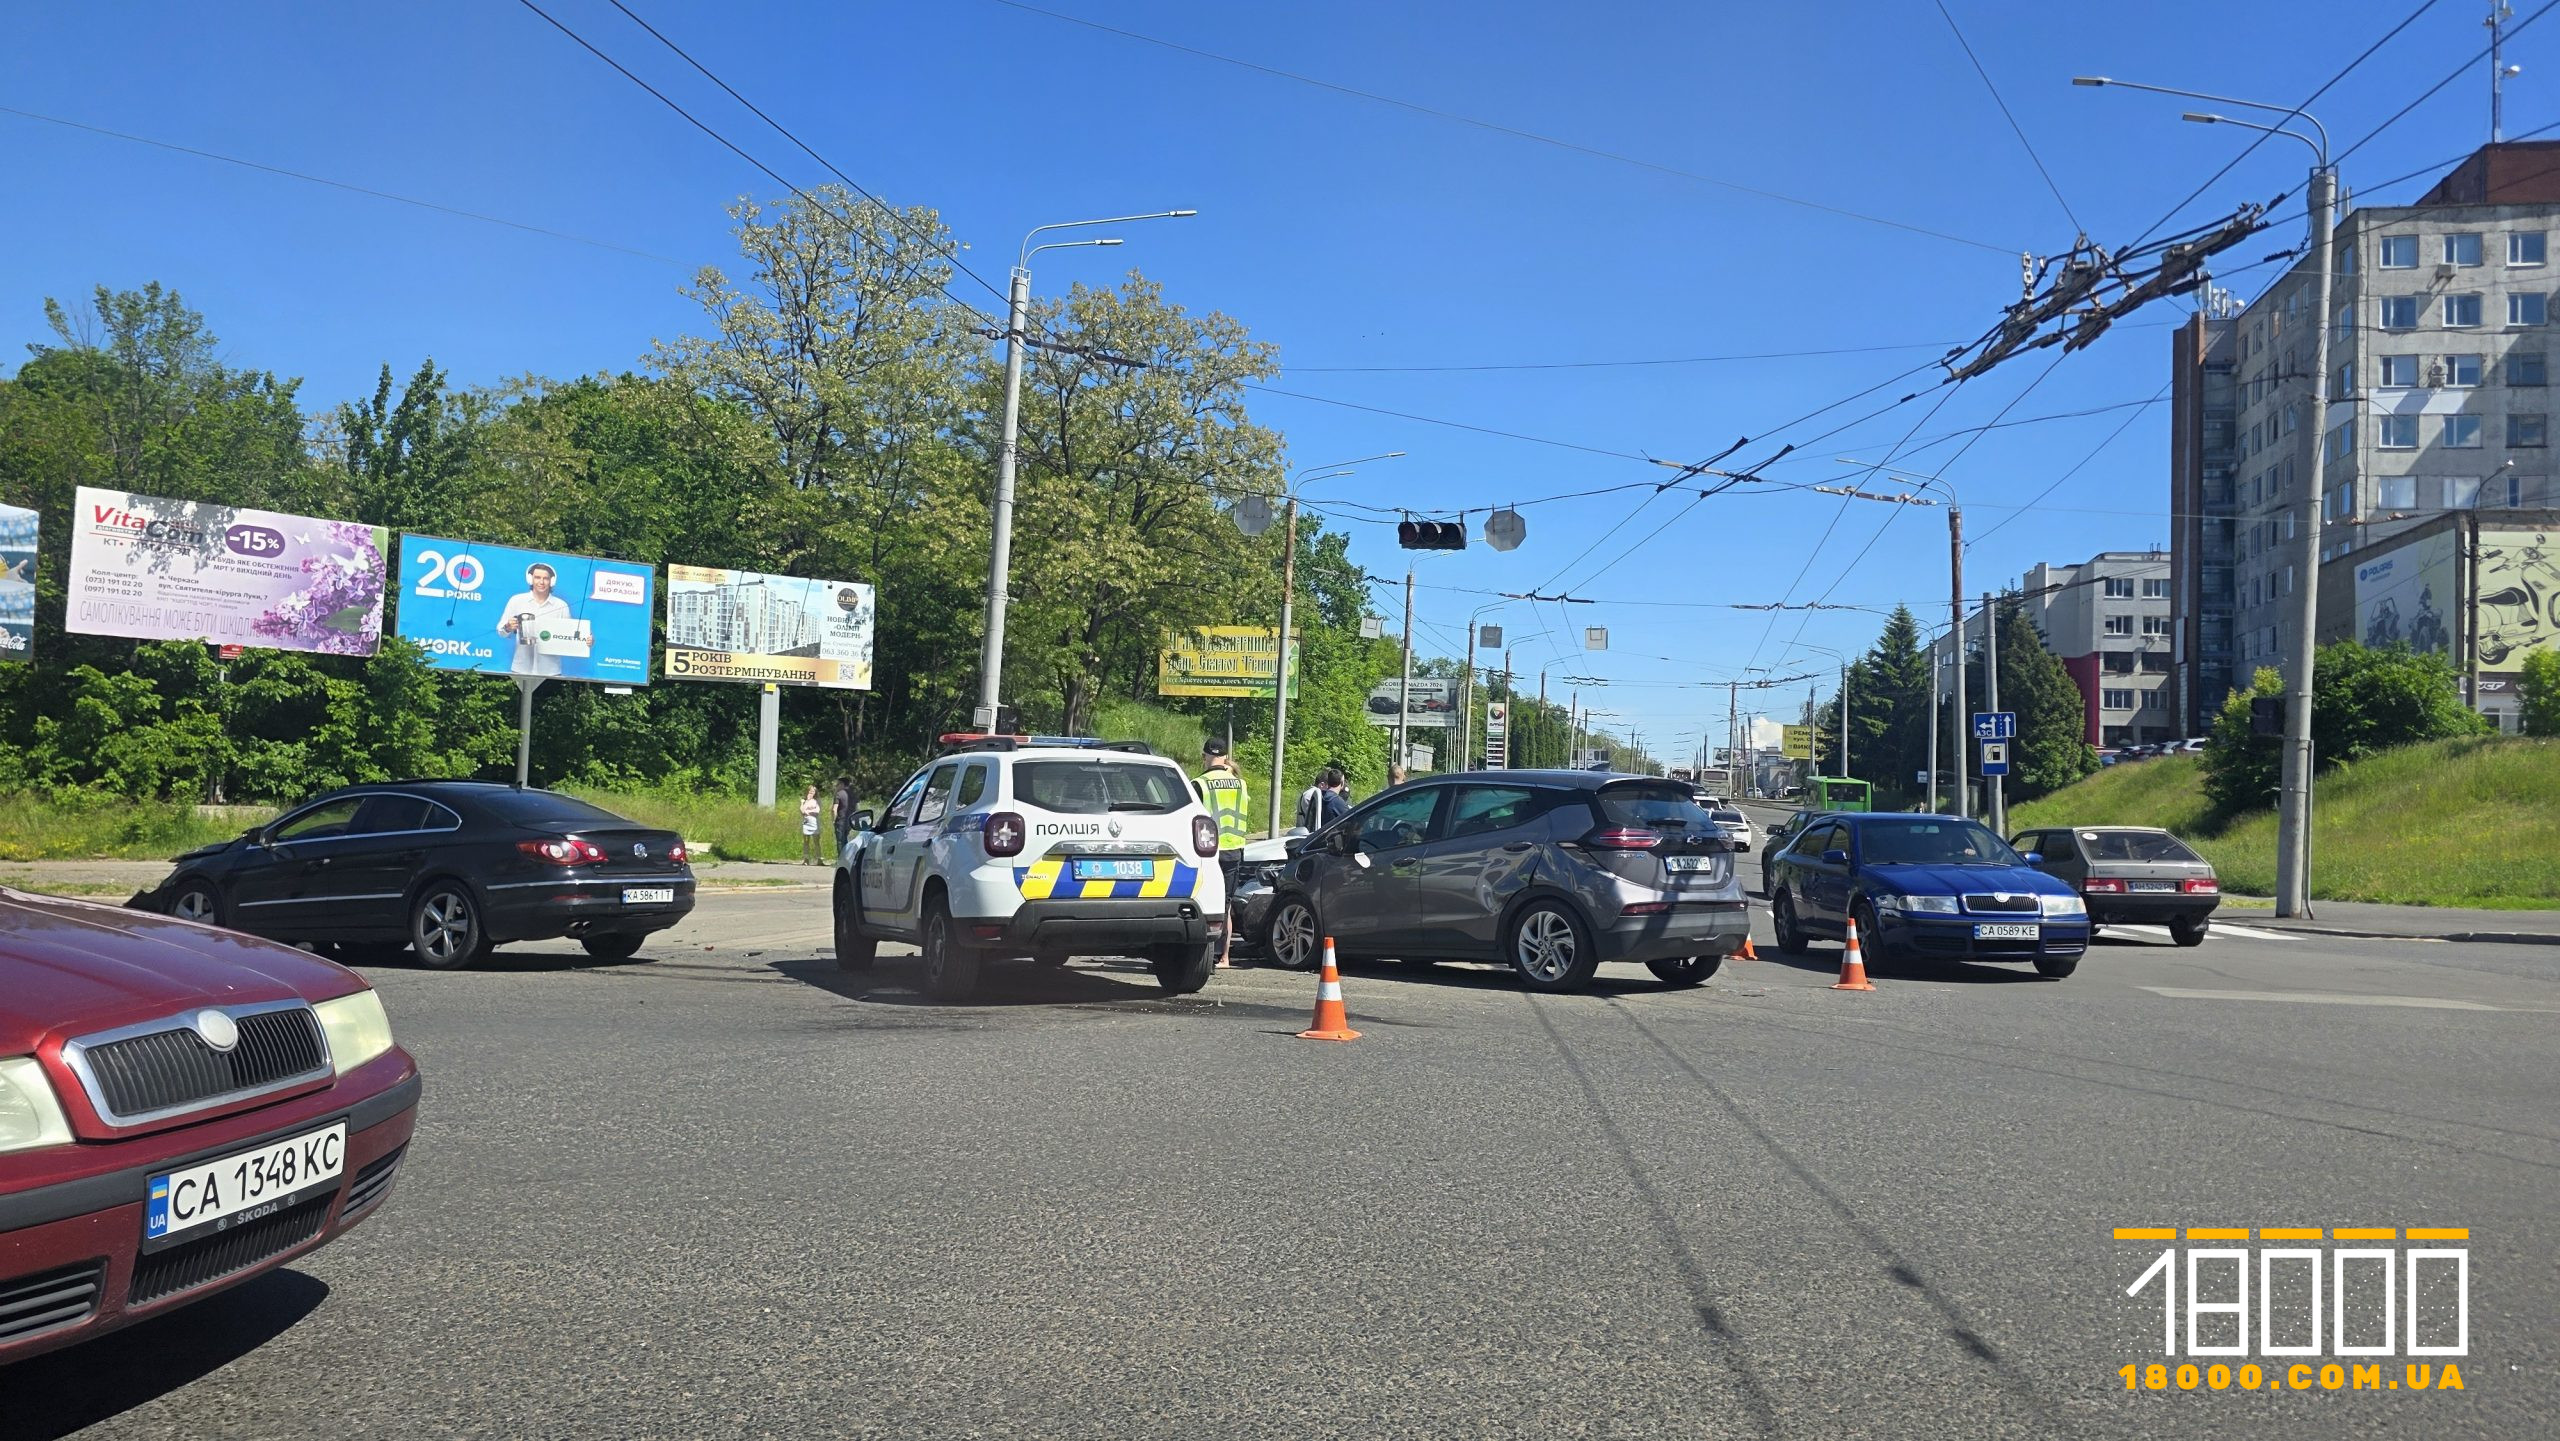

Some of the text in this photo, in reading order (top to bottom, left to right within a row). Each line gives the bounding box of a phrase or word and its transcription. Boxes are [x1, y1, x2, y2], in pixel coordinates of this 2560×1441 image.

[229, 530, 280, 551] -15%
[217, 557, 236, 565] БУДЬ
[252, 561, 300, 573] ОБСТЕЖЕННЯ
[167, 576, 200, 584] Черкаси
[237, 567, 272, 577] ВИХІДНИЙ
[273, 572, 292, 580] ДЕНЬ
[416, 550, 485, 597] 20
[108, 578, 120, 586] 191
[84, 584, 105, 594] (097)
[107, 587, 119, 595] 191
[446, 589, 482, 602] РОКІВ
[80, 600, 161, 628] САМОЛІКУВАННЯ
[163, 609, 192, 631] МОЖЕ
[194, 612, 217, 633] БУТИ
[673, 651, 732, 674] 5 РОКІВ
[691, 665, 817, 681] РОЗТЕРМІНУВАННЯ
[1208, 779, 1241, 789] ПОЛІЦІЯ
[1036, 823, 1100, 835] ПОЛІЦІЯ
[1113, 861, 1143, 875] 1038
[1671, 858, 1683, 870] CA
[627, 890, 638, 901] KA
[1981, 926, 2036, 936] CA 0589 KE
[173, 1132, 340, 1220] CA 1348 KC
[150, 1216, 166, 1229] UA
